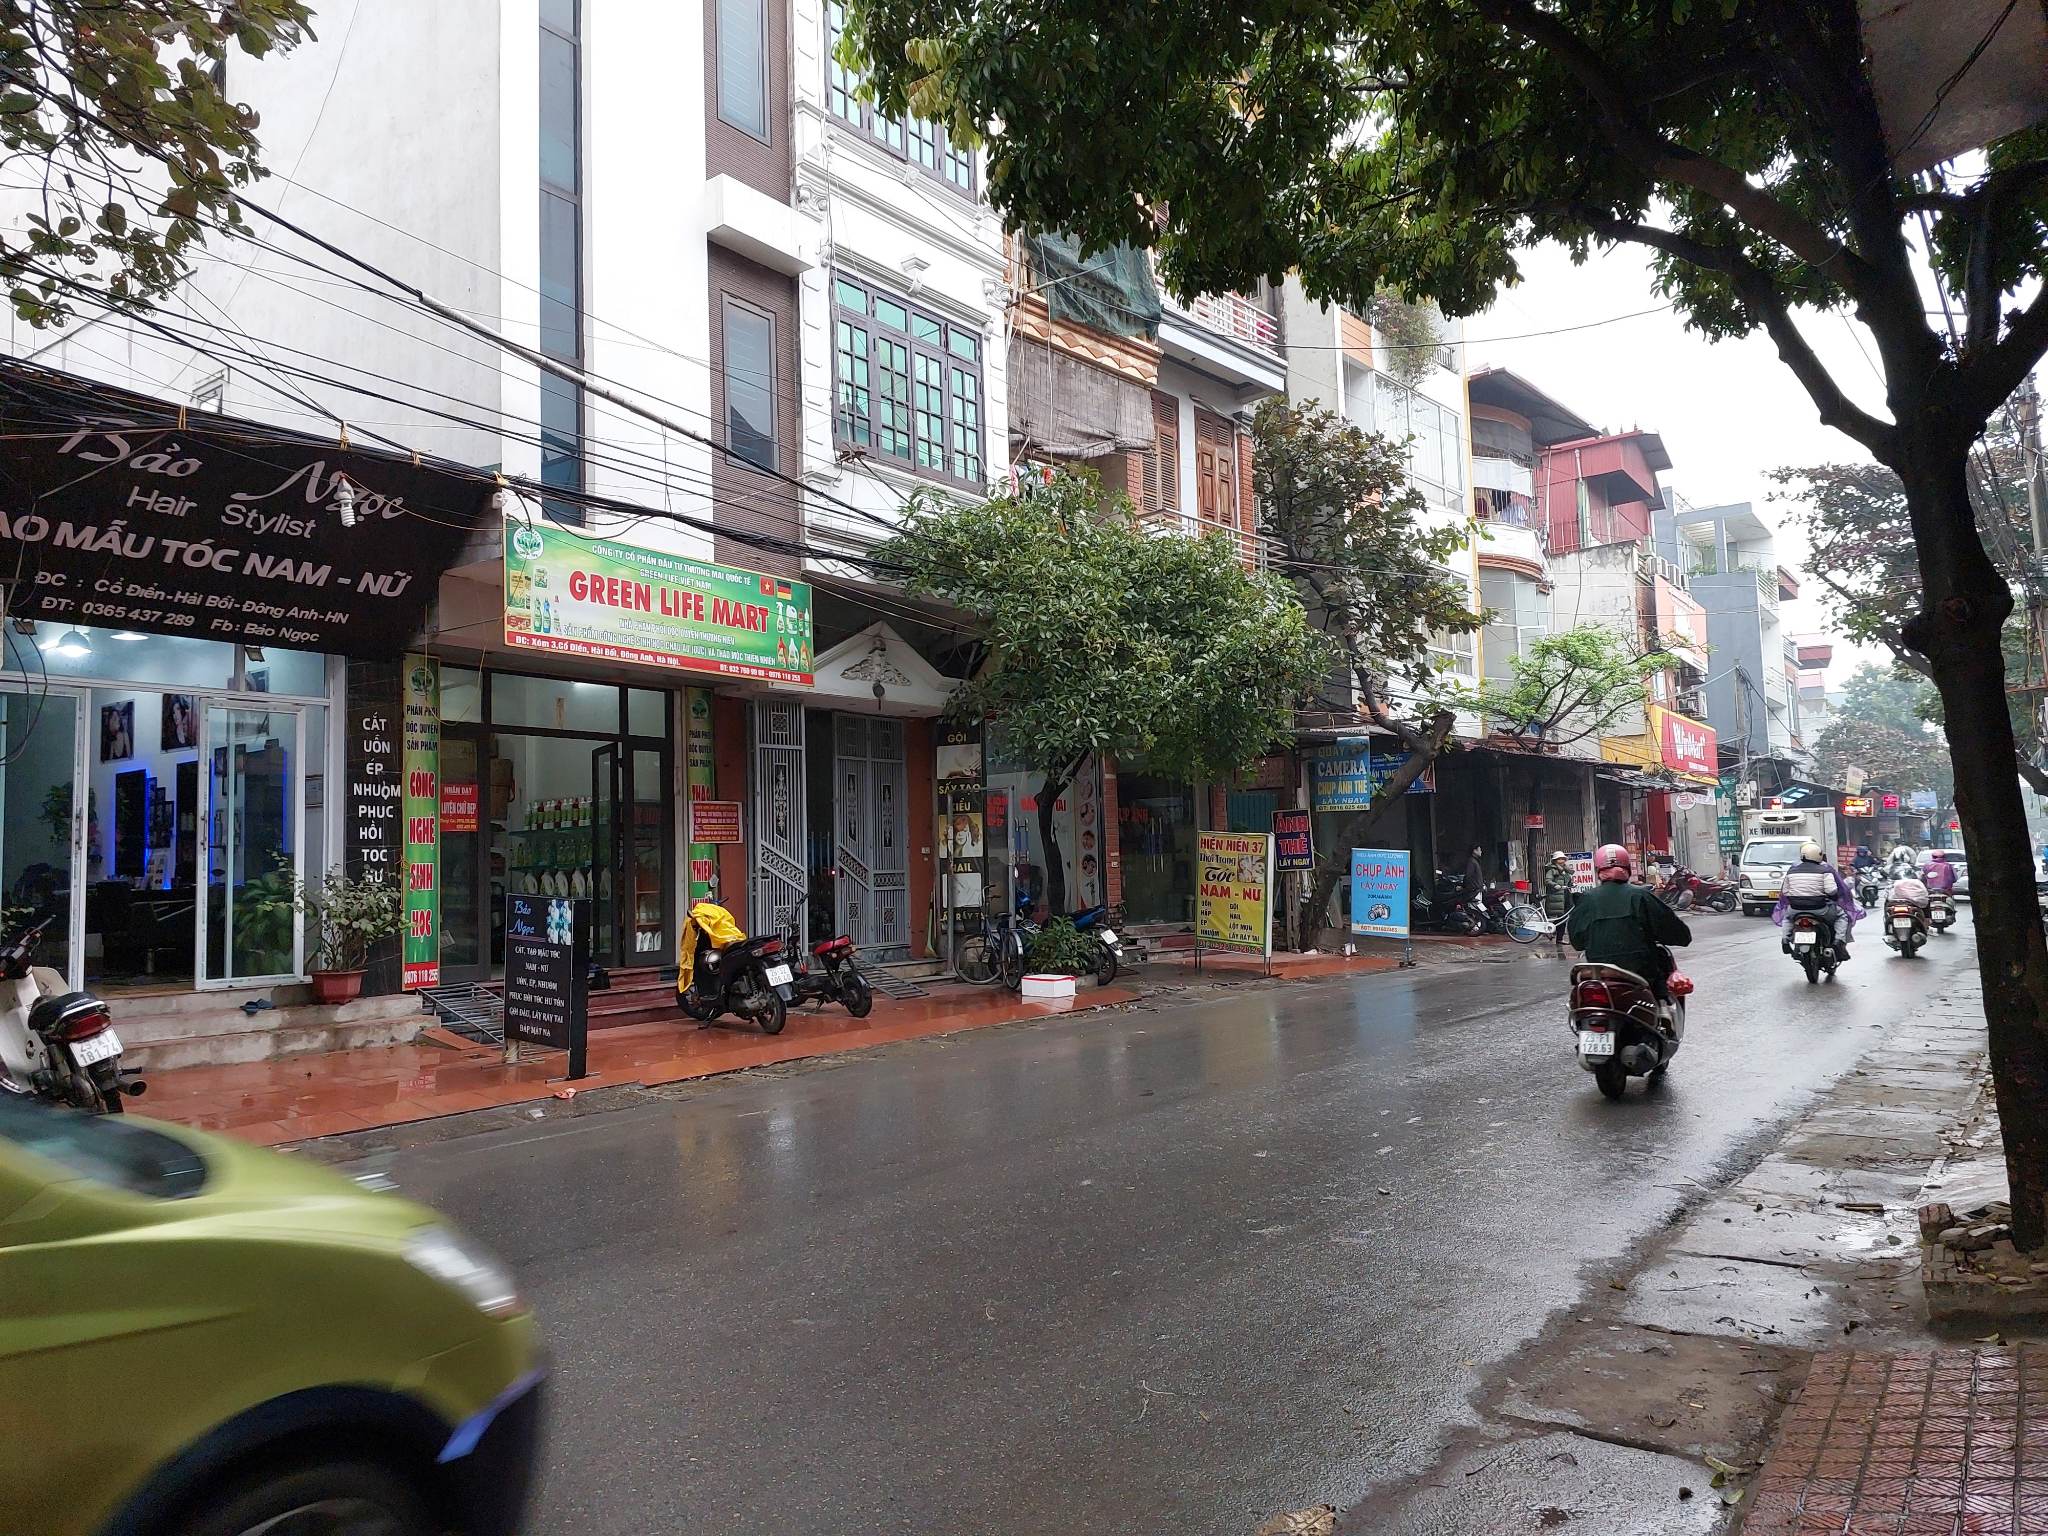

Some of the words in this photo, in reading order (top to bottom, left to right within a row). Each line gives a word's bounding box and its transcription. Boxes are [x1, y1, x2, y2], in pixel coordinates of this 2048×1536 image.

[57, 414, 202, 477] Bảo
[126, 485, 198, 517] Hair
[221, 503, 317, 538] Stylist
[53, 520, 155, 559] MẪU
[161, 538, 240, 573] TÓC
[242, 552, 332, 587] NAM
[337, 577, 351, 585] -
[357, 570, 412, 597] NỮ
[34, 571, 67, 586] ĐC
[94, 576, 123, 593] Cổ
[569, 570, 651, 613] GREEN
[660, 586, 705, 622] LIFE
[711, 597, 769, 633] MART
[41, 596, 76, 611] ĐT:
[82, 602, 127, 618] 0365
[127, 608, 163, 622] 437
[163, 613, 196, 627] 289
[243, 623, 275, 637] Bảo
[278, 627, 320, 643] Ngọc
[515, 635, 529, 645] ĐC:
[531, 638, 550, 648] Xóm
[362, 711, 387, 731] CẮT
[366, 759, 383, 775] ÉP
[1317, 759, 1368, 777] CAMERA
[409, 767, 435, 798] CÔNG
[951, 797, 971, 812] IỂU
[359, 819, 382, 840] HỒI
[1252, 841, 1264, 854] 37
[410, 862, 434, 891] SINH
[1356, 863, 1382, 880] CHỤP
[1385, 862, 1405, 878] ẢNH
[1200, 883, 1231, 898] NAM
[410, 909, 432, 943] HỌC
